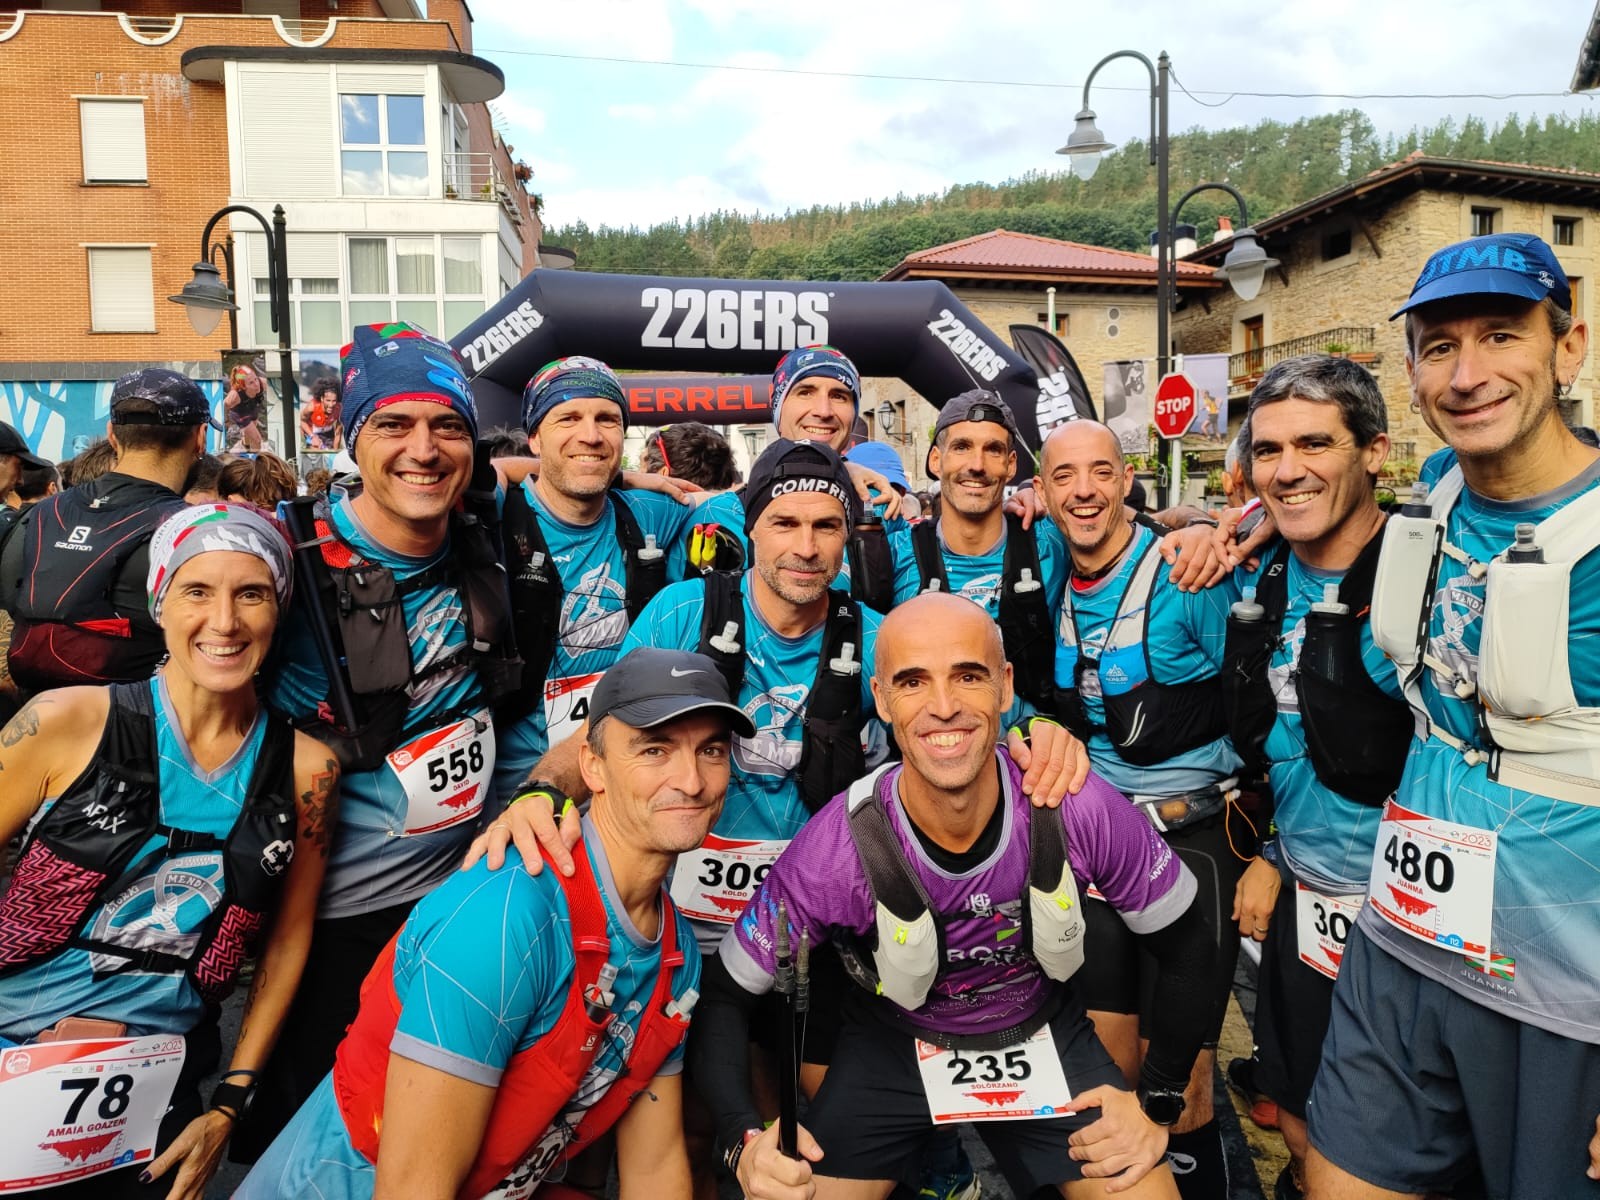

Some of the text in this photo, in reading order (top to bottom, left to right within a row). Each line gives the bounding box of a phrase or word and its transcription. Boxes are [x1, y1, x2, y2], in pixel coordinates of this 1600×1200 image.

[641, 287, 830, 350] 226ERS
[461, 299, 545, 373] 226ERS
[927, 308, 1009, 382] 226ERS
[622, 384, 774, 414] ERREL
[1156, 396, 1192, 415] STOP
[427, 741, 484, 793] 558
[453, 779, 470, 791] DAVID
[1461, 832, 1492, 847] 2023
[698, 858, 774, 891] 309
[1384, 834, 1455, 893] 480
[722, 890, 748, 898] KOLDO
[1396, 879, 1424, 895] JUANMA
[1313, 902, 1353, 945] 30
[1460, 969, 1518, 996] JUANMA
[161, 1040, 183, 1052] 2023
[947, 1050, 1032, 1086] 235
[60, 1074, 134, 1125] 78
[46, 1126, 84, 1138] AMAIA
